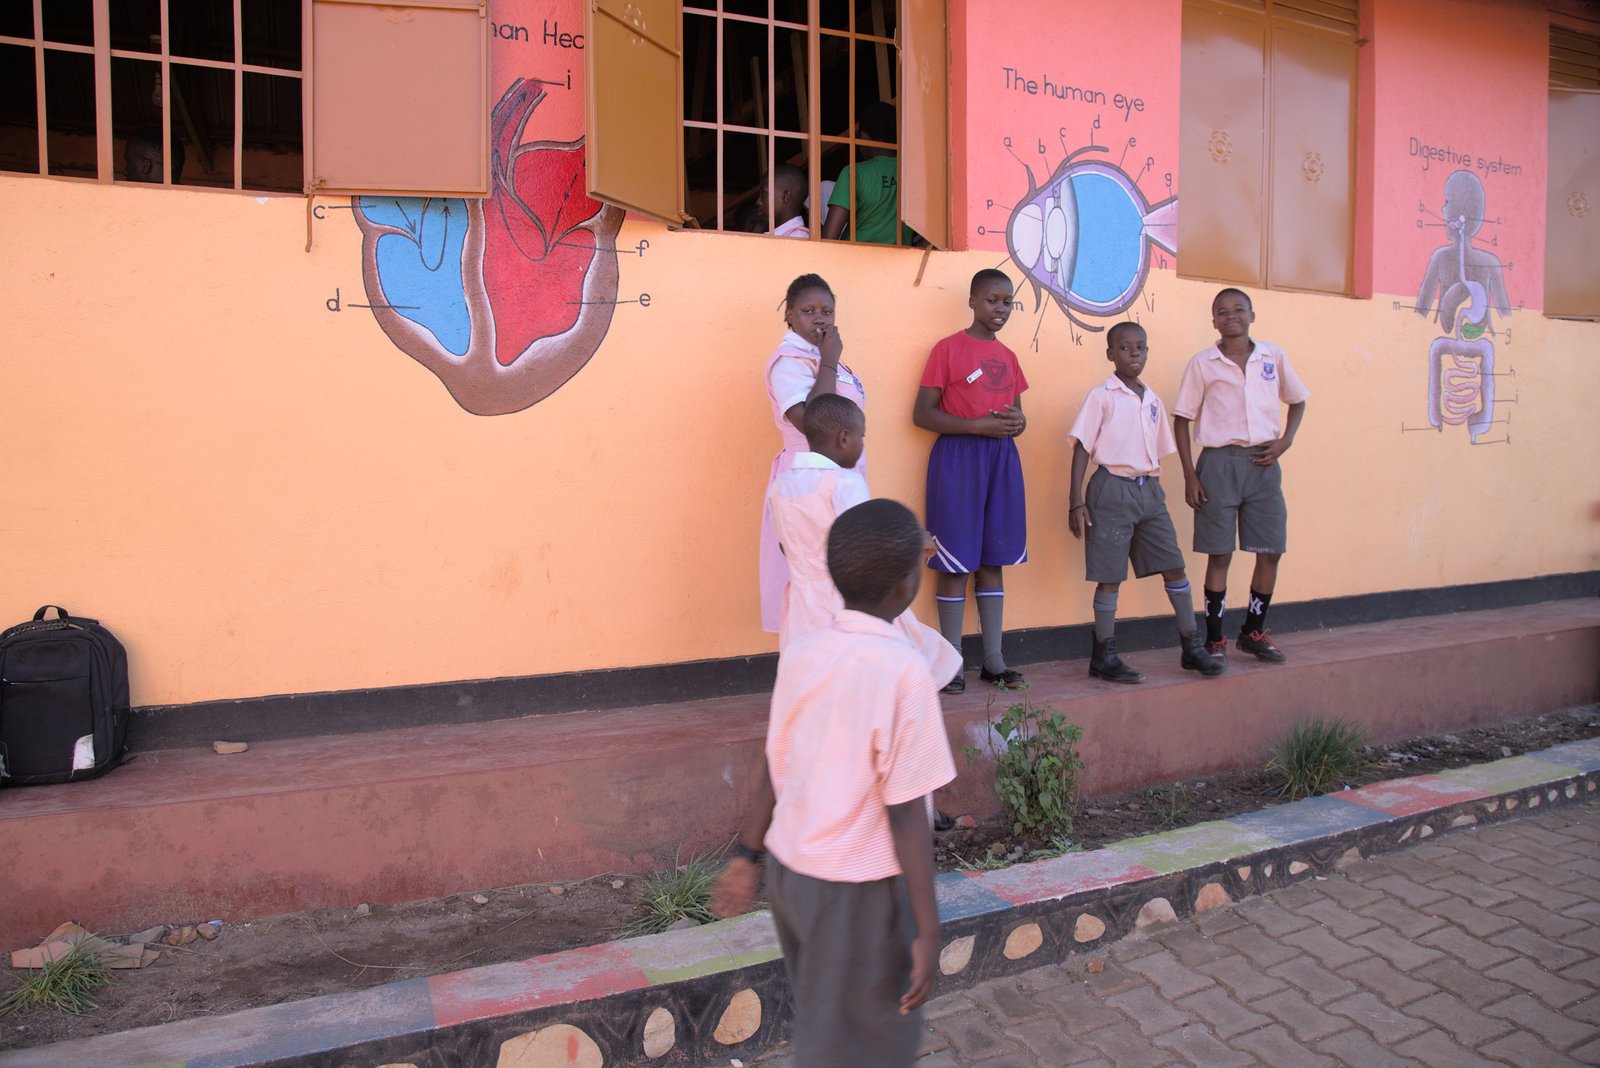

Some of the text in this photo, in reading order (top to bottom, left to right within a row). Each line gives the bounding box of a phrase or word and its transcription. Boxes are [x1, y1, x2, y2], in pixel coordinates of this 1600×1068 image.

[1002, 67, 1145, 122] The human eye
[1409, 136, 1523, 179] Digestive system
[313, 204, 325, 220] c
[326, 287, 341, 312] d
[639, 292, 651, 307] e
